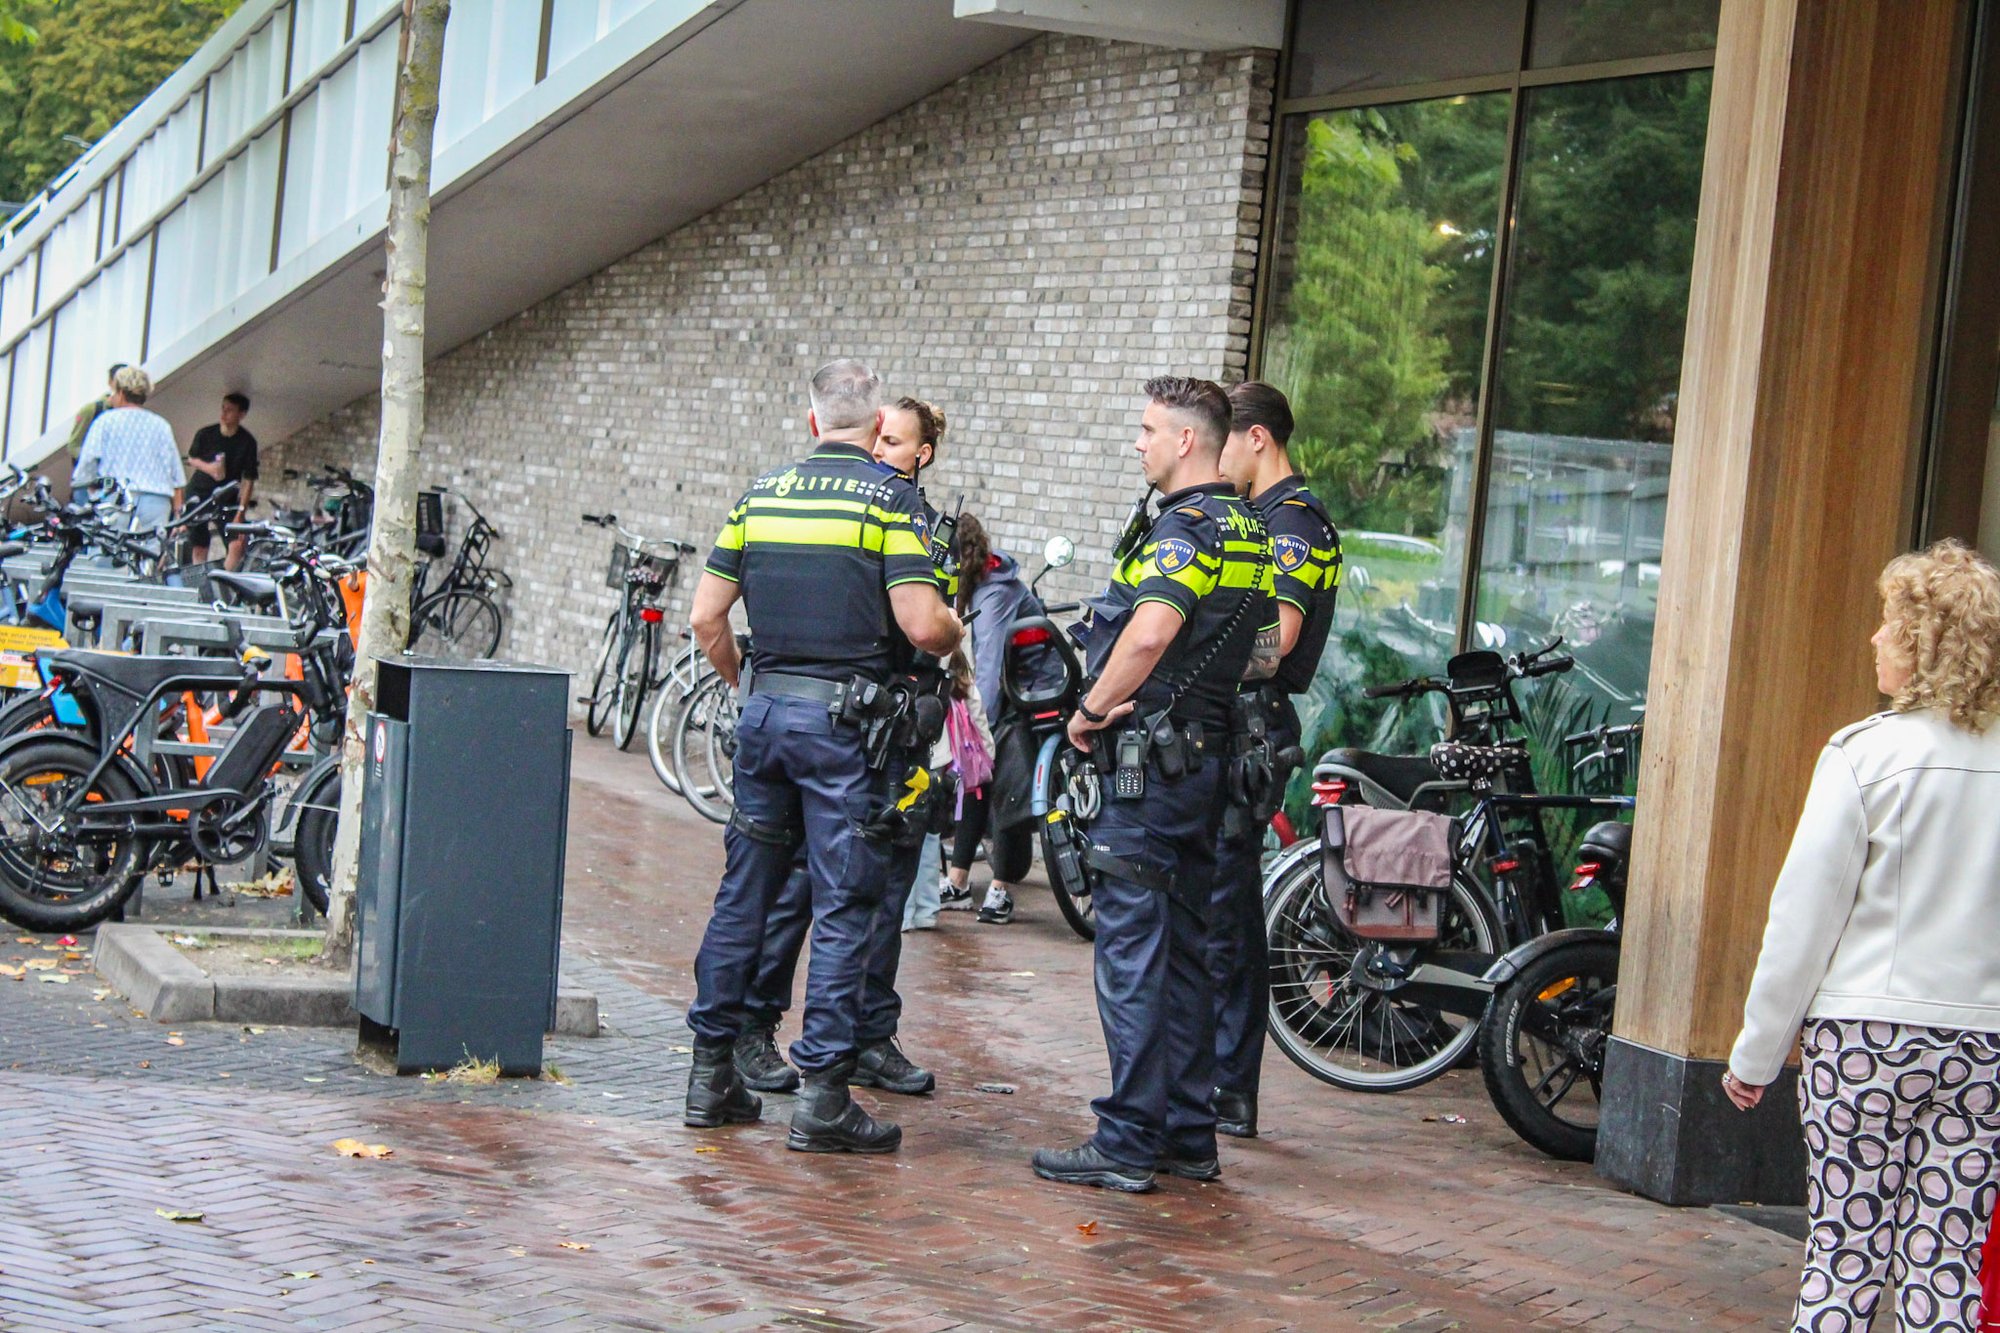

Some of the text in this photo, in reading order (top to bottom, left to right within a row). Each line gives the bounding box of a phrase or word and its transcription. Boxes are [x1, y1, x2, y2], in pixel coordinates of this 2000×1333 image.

[765, 472, 860, 497] POLITIE
[1160, 543, 1191, 554] POLITIE
[1277, 538, 1306, 551] POLITIE
